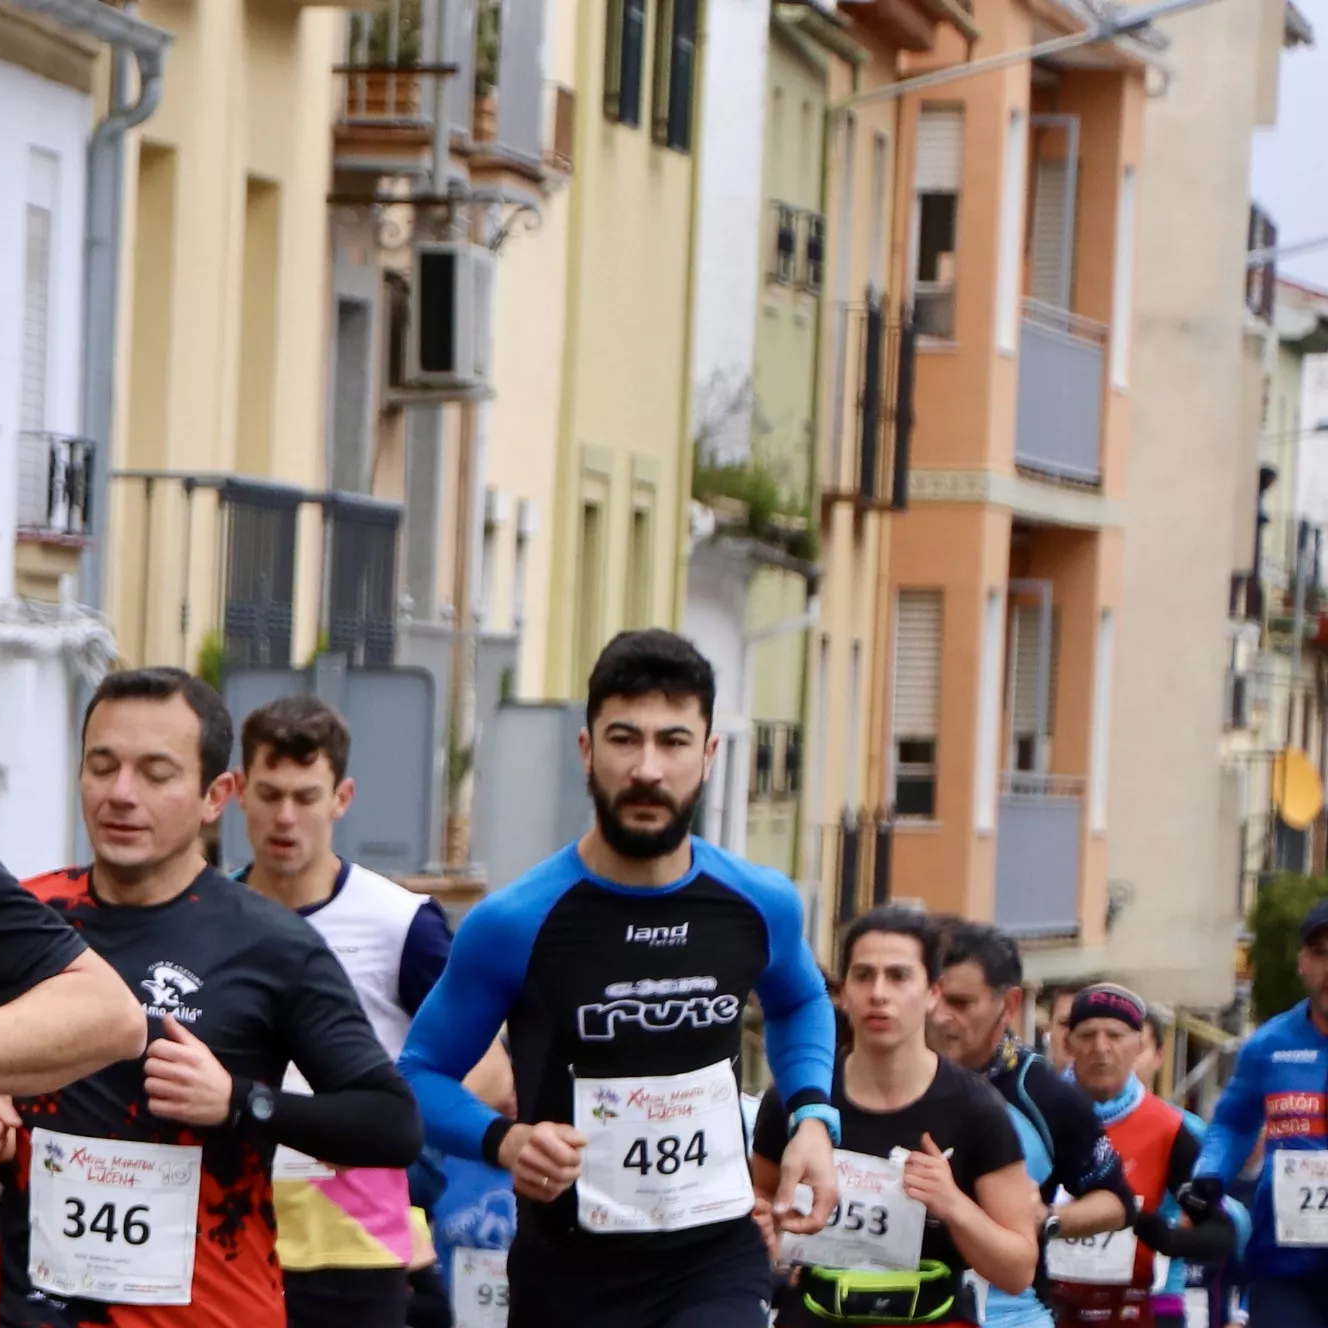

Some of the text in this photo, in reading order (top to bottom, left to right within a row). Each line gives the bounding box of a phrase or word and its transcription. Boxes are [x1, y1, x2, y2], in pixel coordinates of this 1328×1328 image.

[625, 922, 690, 944] land
[577, 994, 740, 1041] rute
[623, 1128, 708, 1176] 484
[87, 1167, 137, 1187] LUCENA
[62, 1196, 151, 1246] 346
